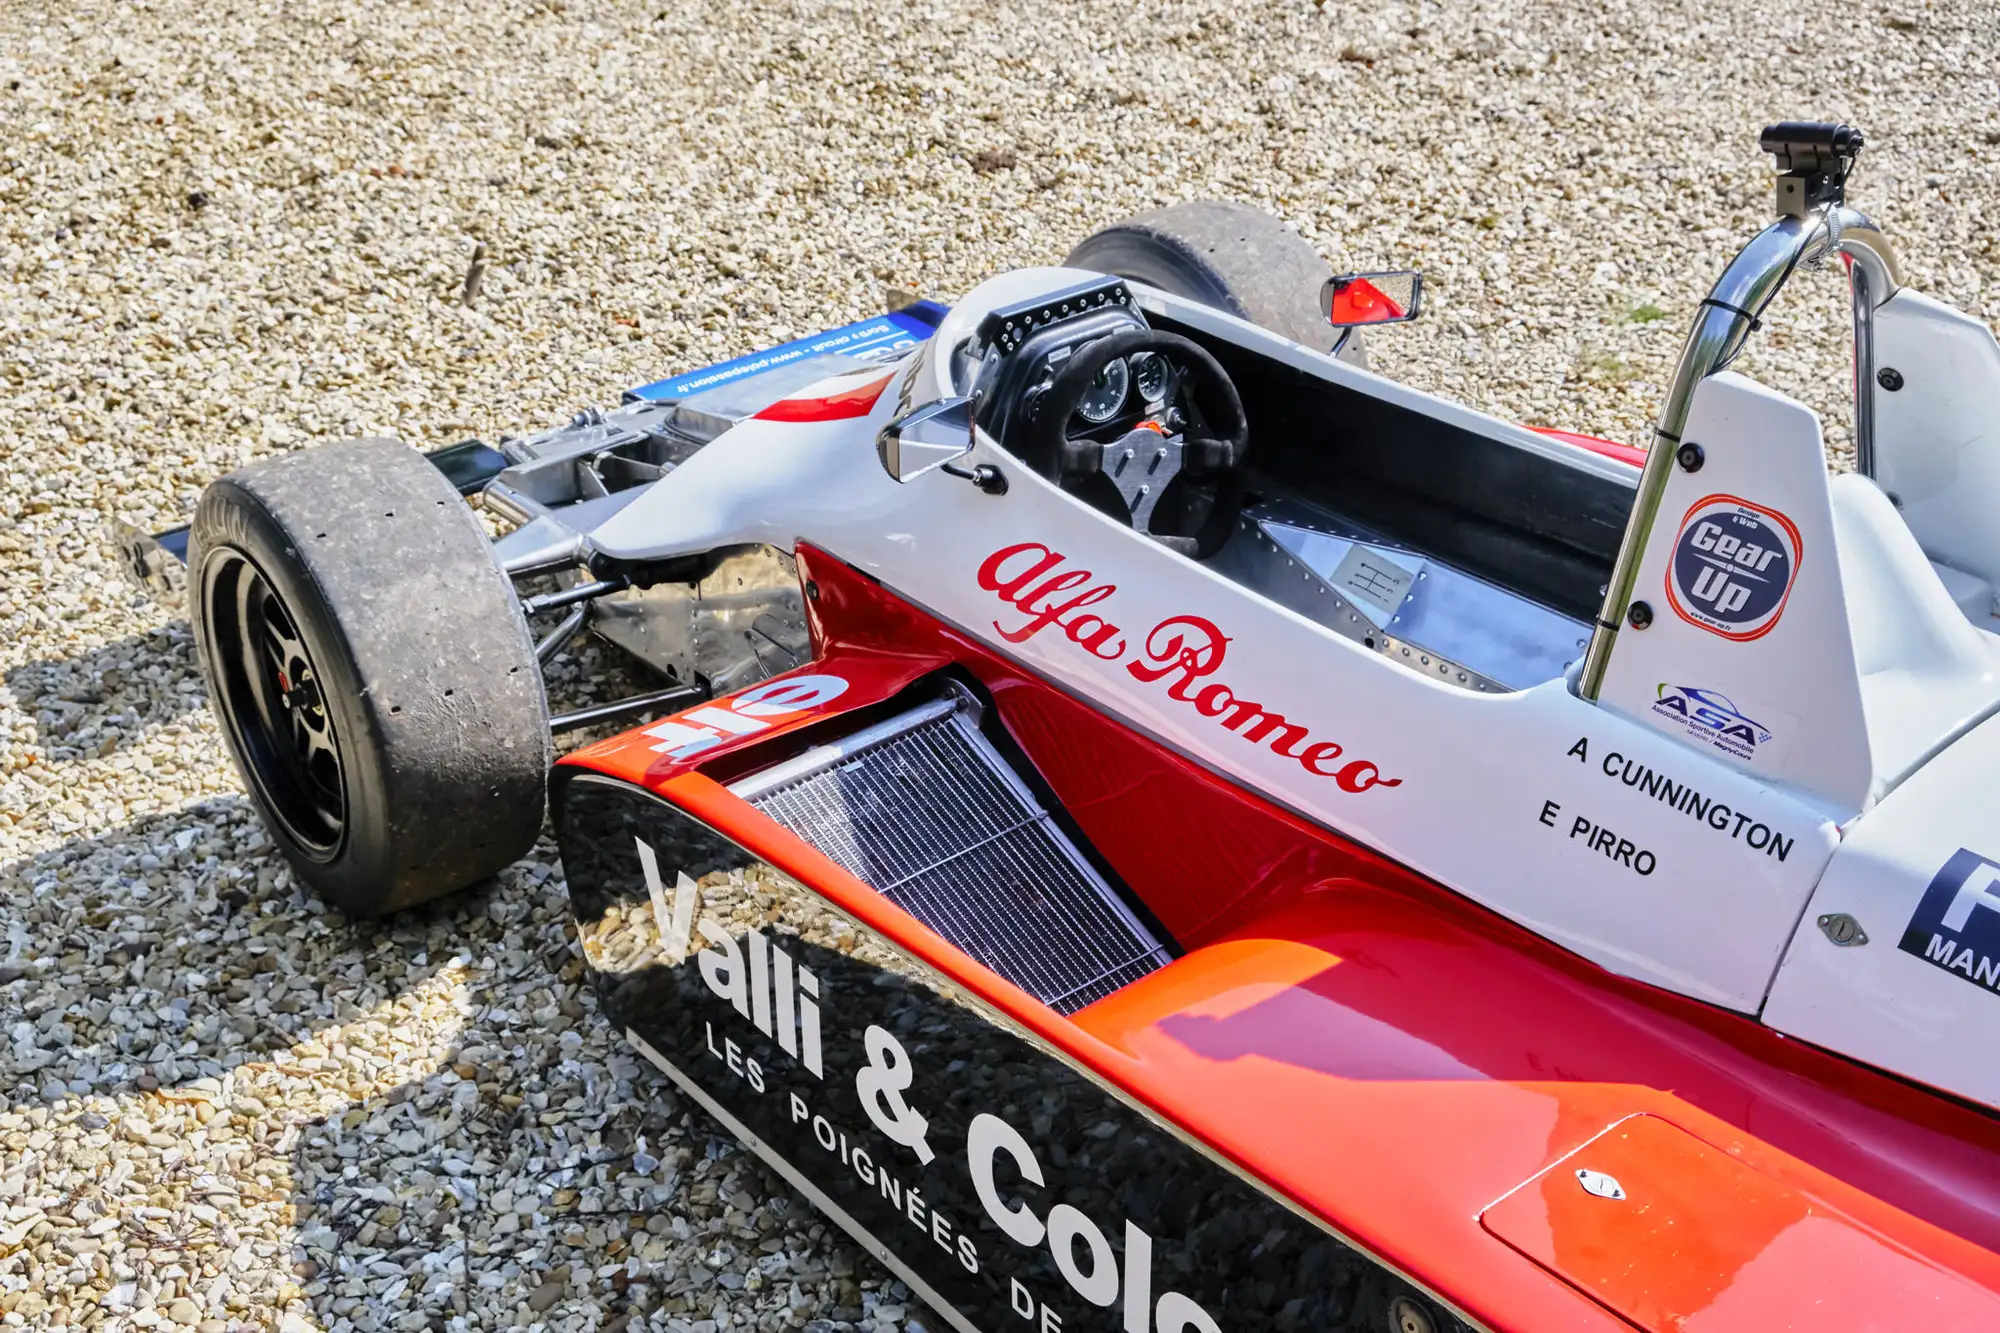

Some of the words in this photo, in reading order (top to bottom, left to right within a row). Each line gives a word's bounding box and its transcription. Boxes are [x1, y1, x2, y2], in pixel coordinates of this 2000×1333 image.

[1737, 507, 1760, 520] Design
[1739, 516, 1758, 530] Web
[1690, 521, 1783, 572] Gear
[1691, 566, 1752, 613] Up
[977, 542, 1126, 660] Alfa
[1126, 615, 1403, 793] Romeo
[641, 674, 850, 759] elf
[1651, 704, 1688, 725] Association
[1688, 721, 1716, 738] Sportive
[1716, 733, 1755, 755] Automobile
[1655, 695, 1756, 746] ASA
[1567, 737, 1588, 763] A
[1602, 752, 1794, 862] CUNNINGTON
[1539, 800, 1560, 827] E
[1570, 816, 1656, 876] PIRRO
[1924, 933, 2000, 991] MAN
[634, 836, 824, 1081] Valli
[856, 1025, 935, 1165] &
[705, 1021, 765, 1094] LES
[790, 1092, 979, 1274] POIGNÉES
[1011, 1277, 1062, 1333] DE
